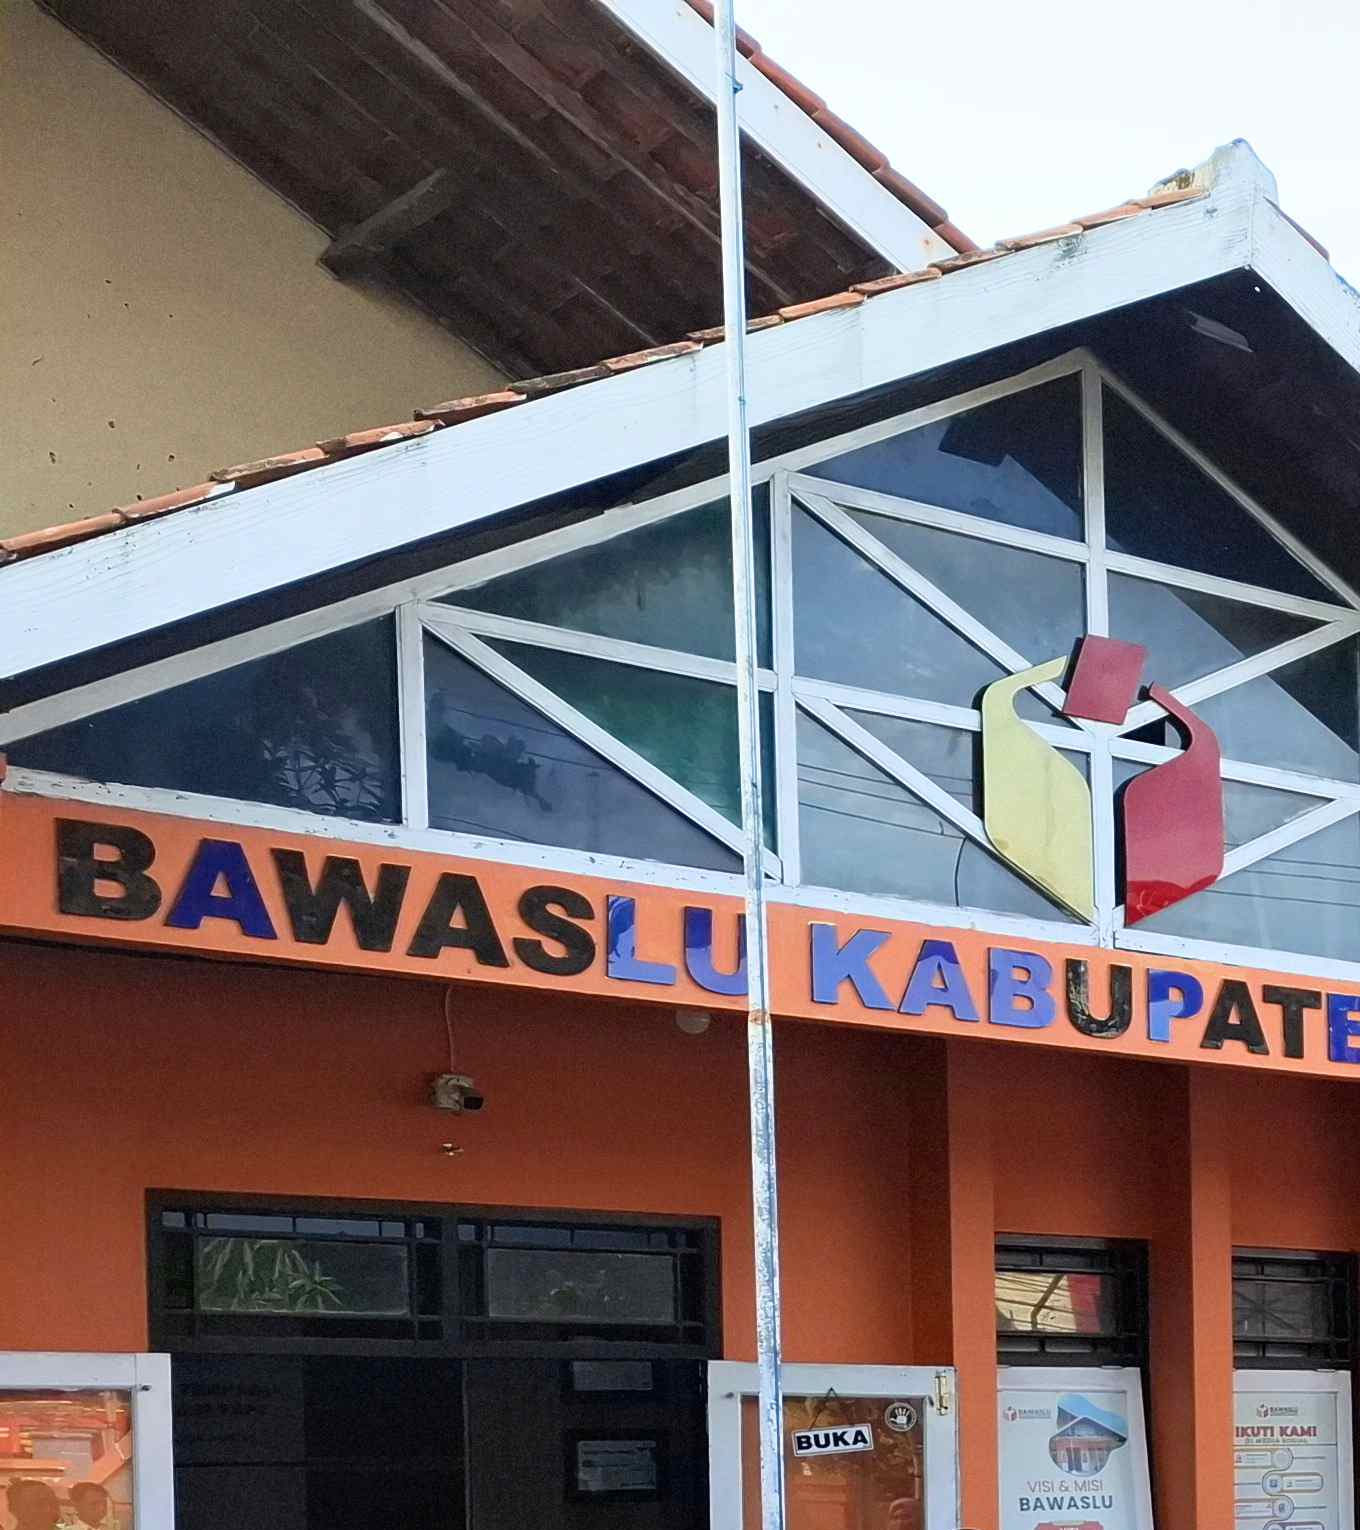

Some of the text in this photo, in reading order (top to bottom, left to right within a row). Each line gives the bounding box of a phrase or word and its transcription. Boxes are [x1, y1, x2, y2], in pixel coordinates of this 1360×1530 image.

[55, 816, 750, 998] BAWASLU
[795, 1429, 869, 1451] BUKA
[1235, 1425, 1317, 1438] IKUTI KAMI
[1027, 1479, 1104, 1493] VISI & MISI
[1019, 1495, 1113, 1512] BAWASLU
